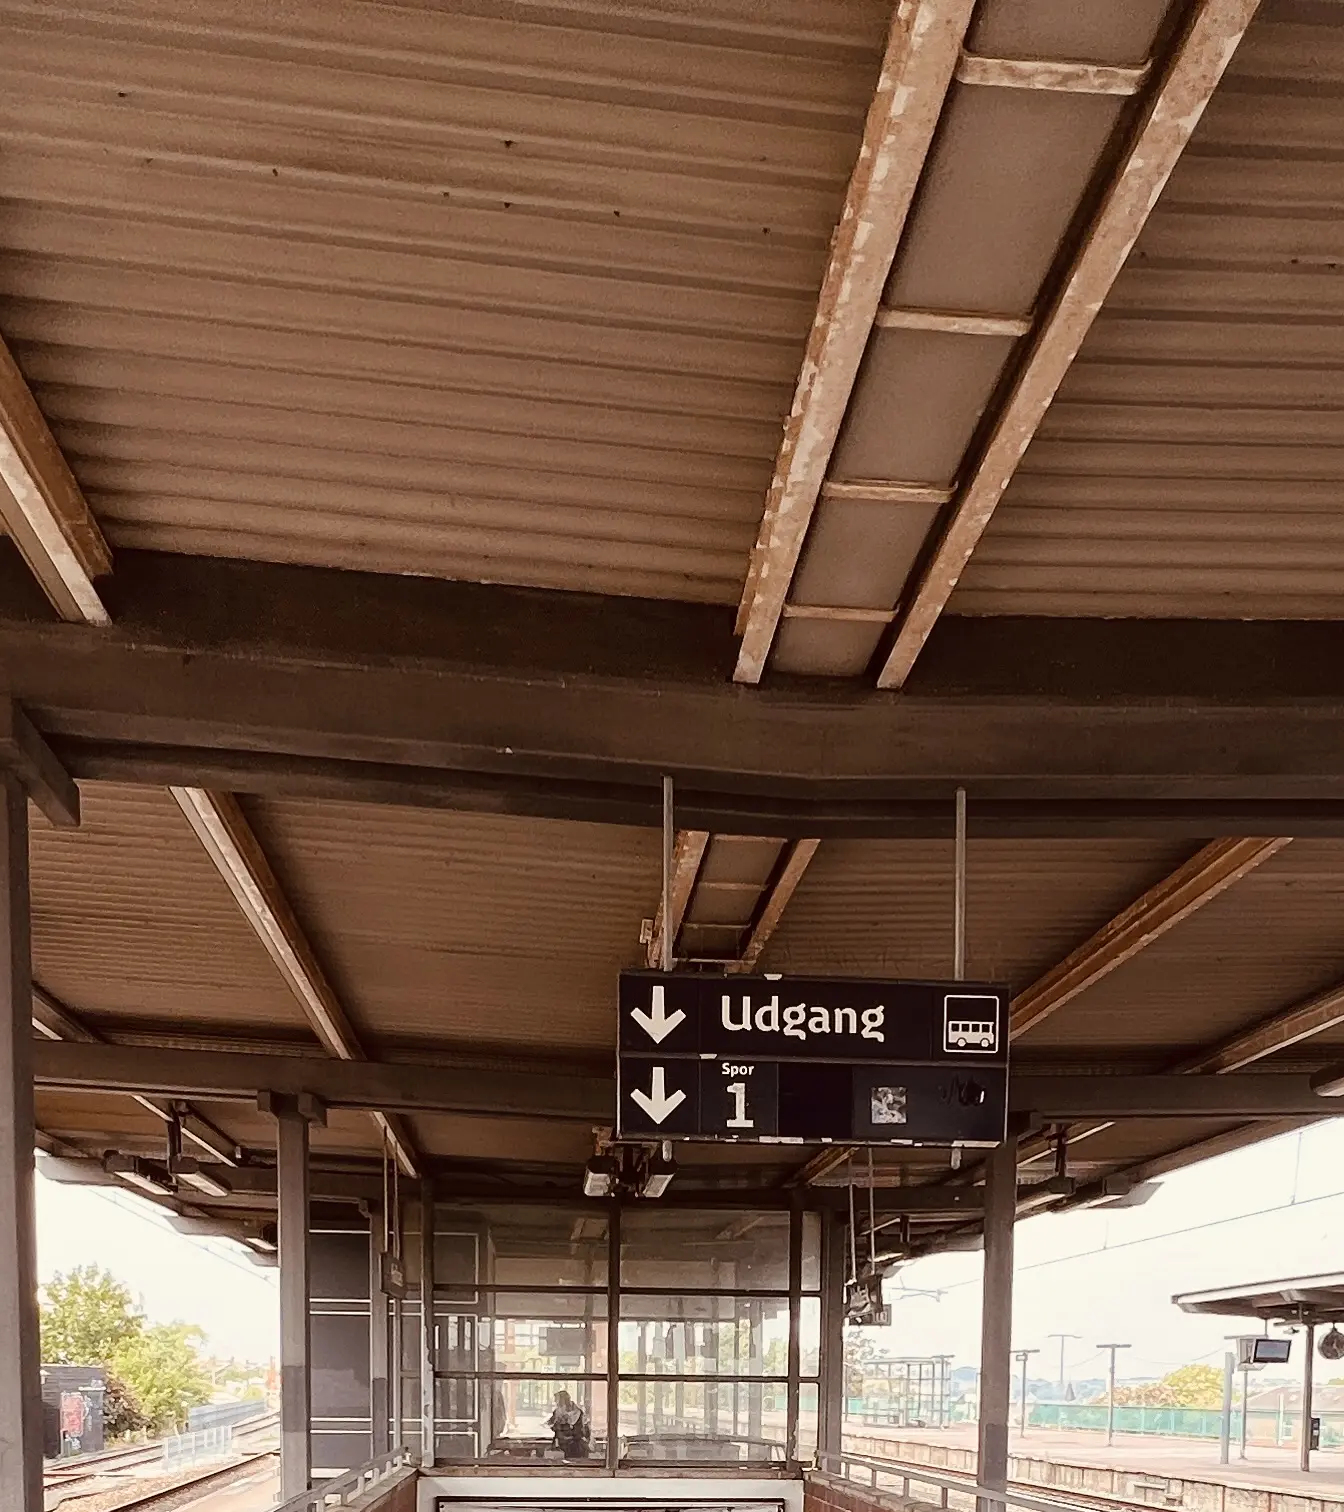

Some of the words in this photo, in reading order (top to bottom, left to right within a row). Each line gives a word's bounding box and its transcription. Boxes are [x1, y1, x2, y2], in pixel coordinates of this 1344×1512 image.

[721, 995, 885, 1043] Udgang
[721, 1062, 755, 1078] Spor
[726, 1082, 754, 1128] 1
